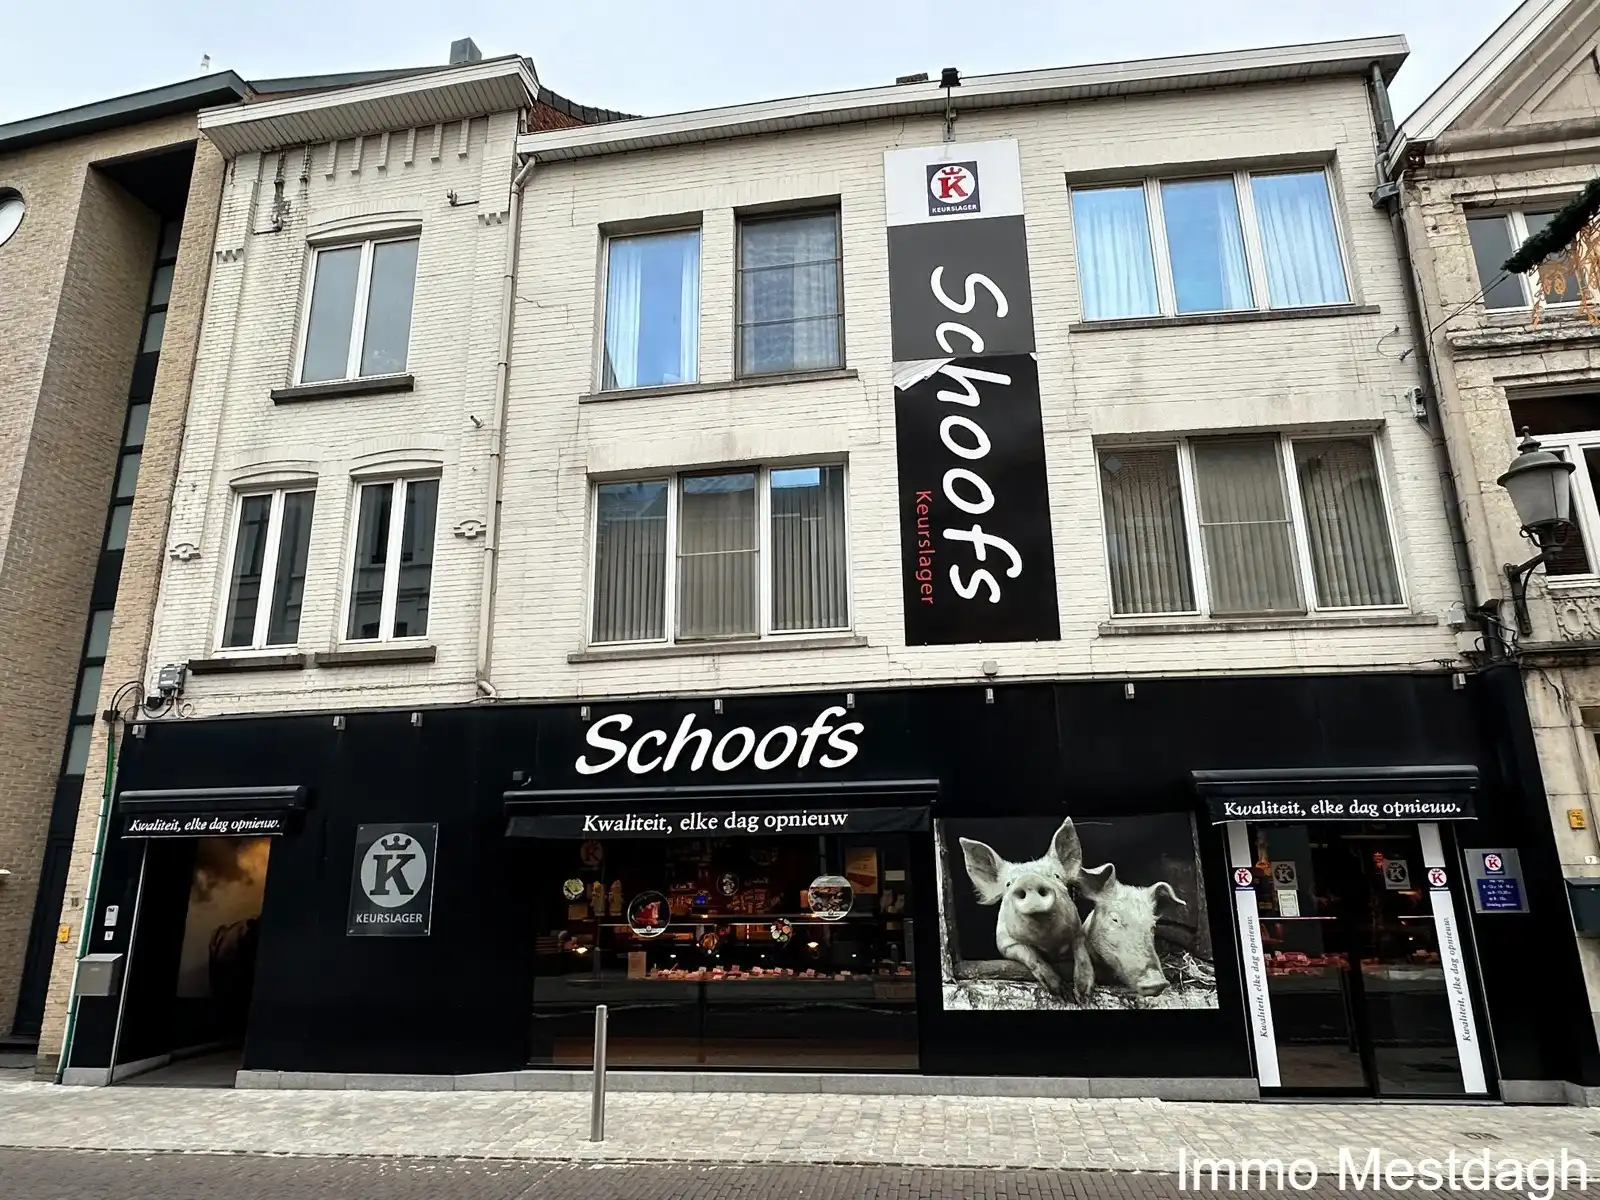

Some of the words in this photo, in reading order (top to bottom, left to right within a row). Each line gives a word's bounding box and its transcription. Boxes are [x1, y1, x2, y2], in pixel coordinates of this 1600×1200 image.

[938, 175, 968, 199] K
[931, 204, 977, 214] KEURSLAGER
[930, 265, 1023, 605] Schoofs
[915, 490, 935, 604] Keurslager
[574, 705, 865, 775] Schoofs
[1224, 800, 1306, 817] Kwaliteit,
[1311, 799, 1344, 814] elke
[1349, 800, 1380, 817] dag
[1383, 799, 1461, 817] opnieuw.
[129, 818, 181, 832] Kwaliteit,
[184, 817, 207, 831] elke
[209, 817, 228, 833] dag
[231, 817, 280, 832] opnieuw.
[582, 813, 673, 834] Kwaliteit,
[680, 812, 718, 830] elke
[724, 811, 760, 832] dag
[764, 810, 848, 832] opnieuw
[1487, 859, 1499, 868] K
[370, 854, 416, 895] K
[1237, 872, 1249, 883] K
[1279, 869, 1293, 882] K
[1388, 868, 1404, 880] K
[1431, 873, 1444, 883] K
[356, 913, 423, 923] KEURSLAGER
[1251, 956, 1260, 972] dag
[1450, 958, 1459, 975] dag
[1252, 973, 1261, 992] elke
[1452, 976, 1462, 995] elke
[1257, 994, 1268, 1038] Kwaliteit,
[1456, 997, 1471, 1042] Kwaliteit,
